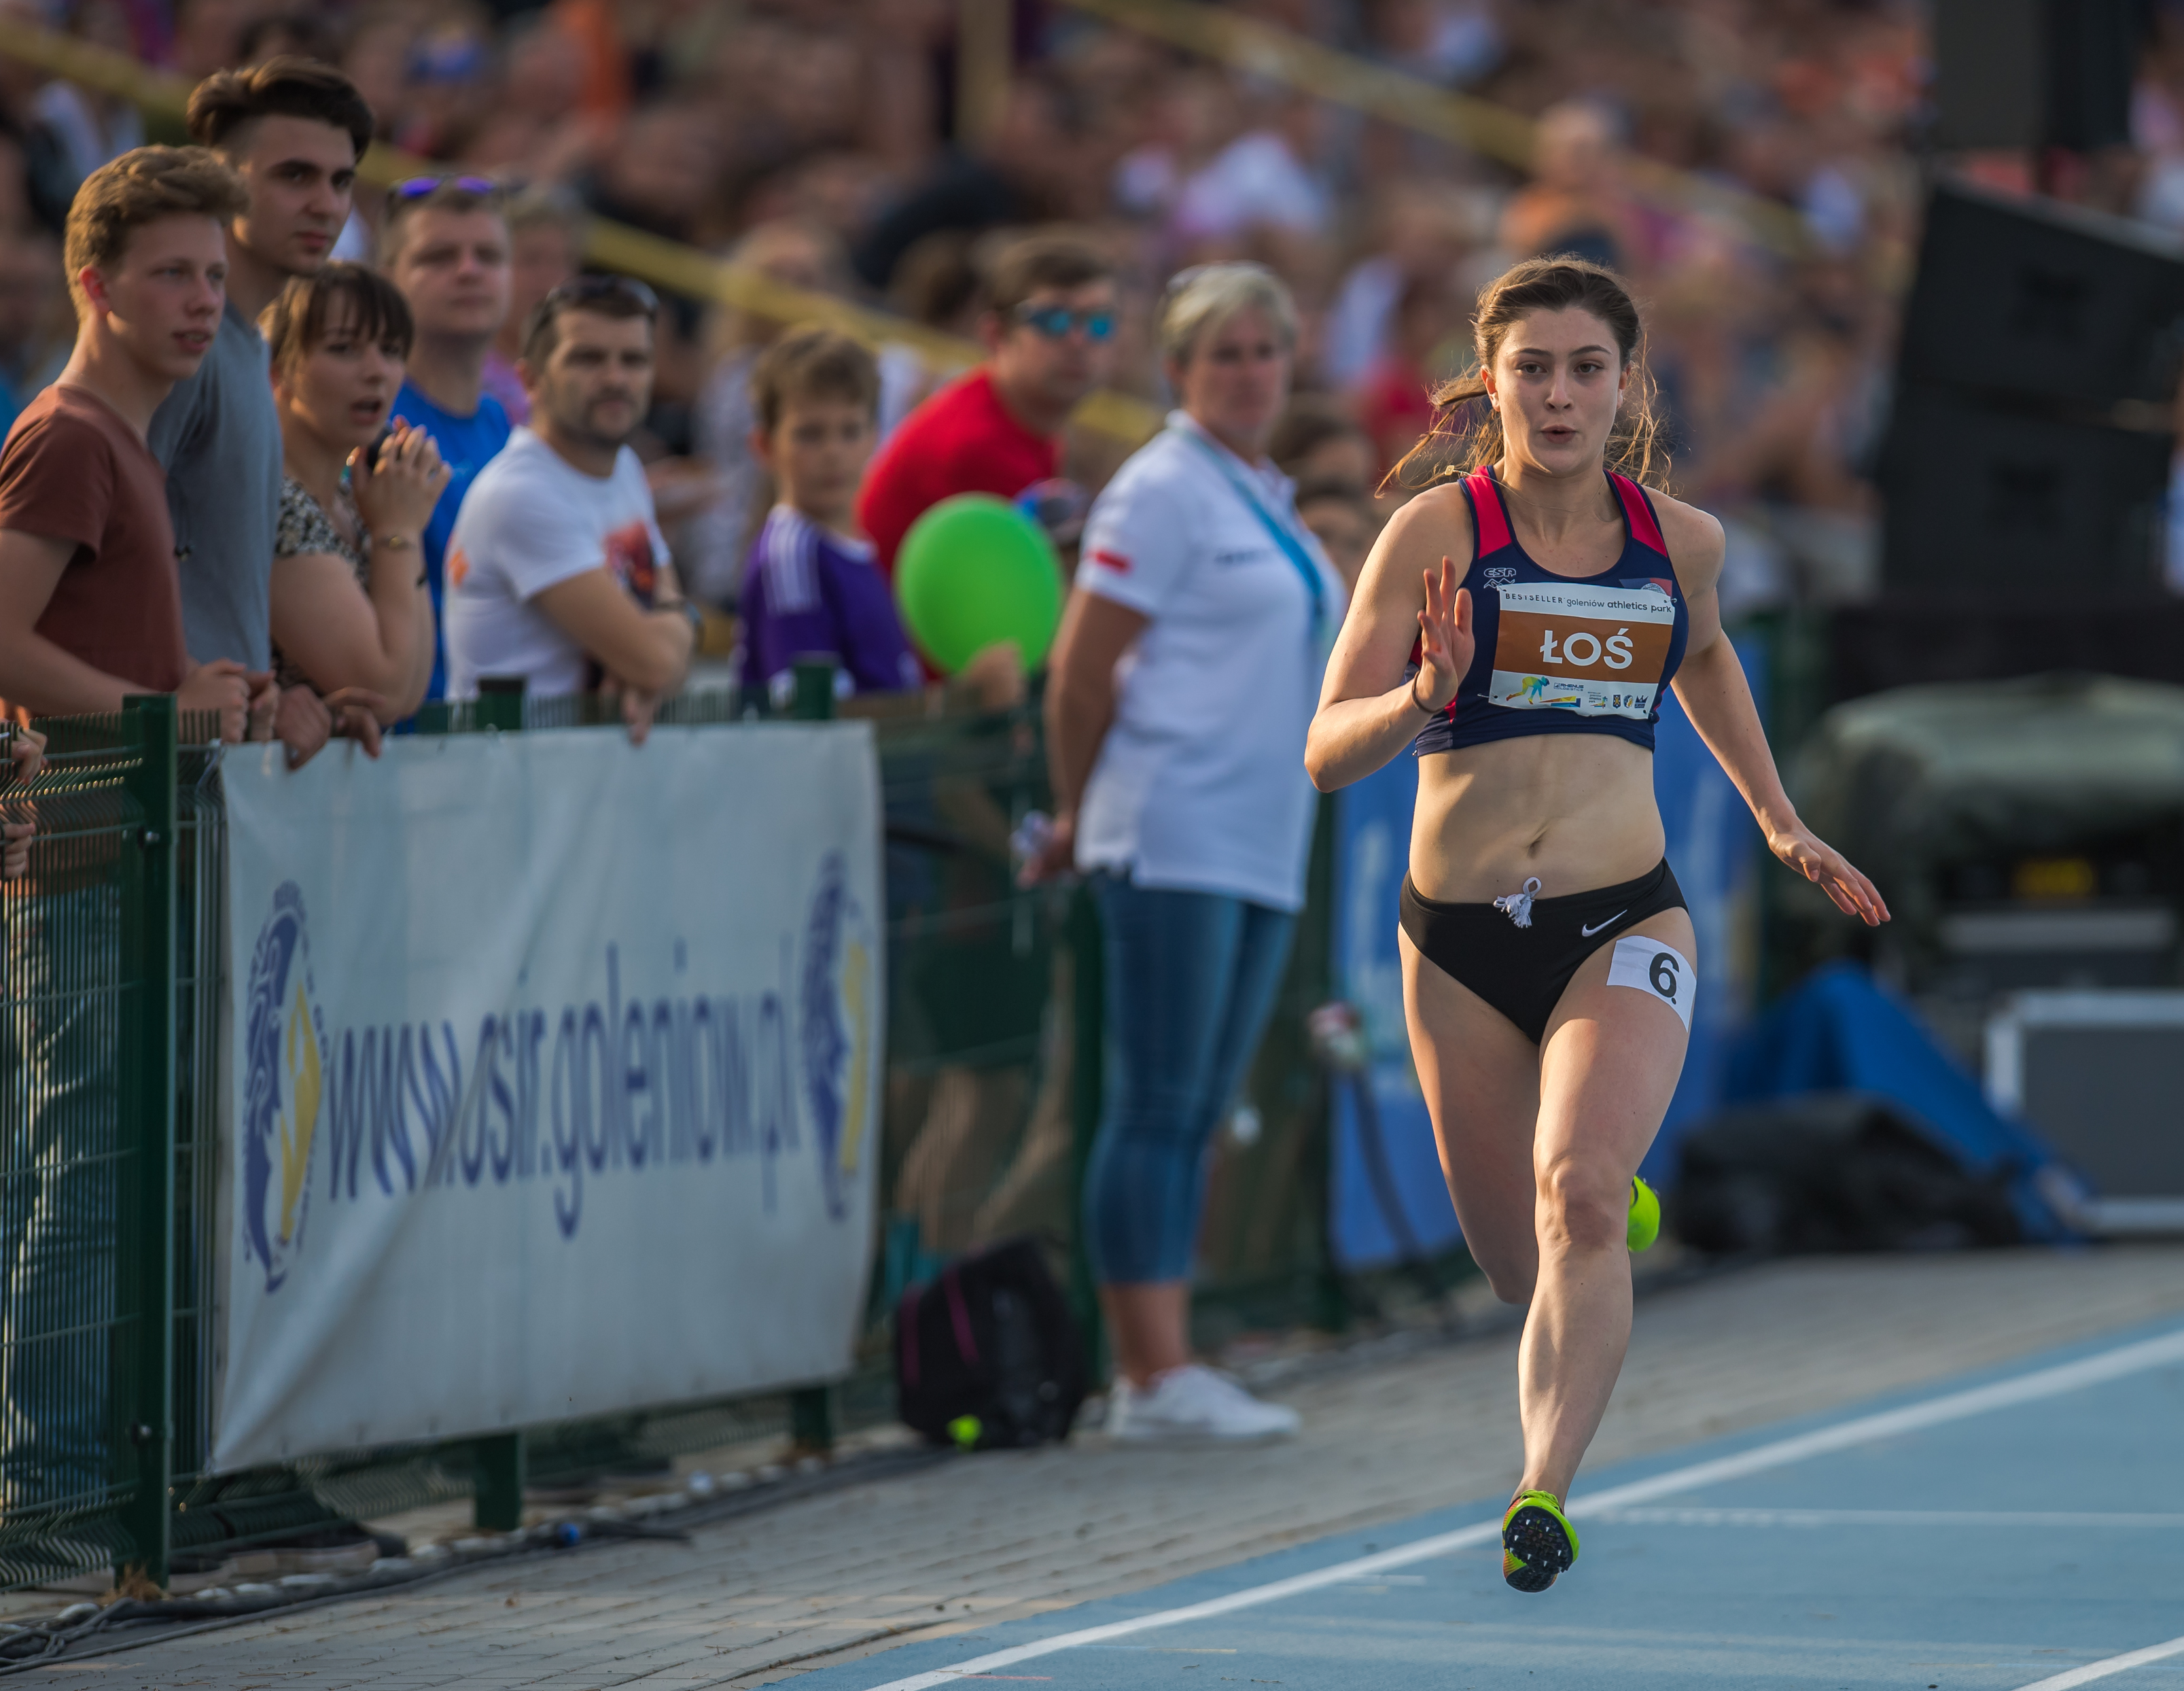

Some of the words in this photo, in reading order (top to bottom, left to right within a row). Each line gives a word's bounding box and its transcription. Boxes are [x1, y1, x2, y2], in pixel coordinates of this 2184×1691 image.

[1505, 593, 1564, 604] BESTSELLER
[1566, 598, 1604, 608] goleniów
[1607, 600, 1647, 611] athletics
[1651, 604, 1672, 614] park
[1539, 627, 1634, 670] ŁOŚ
